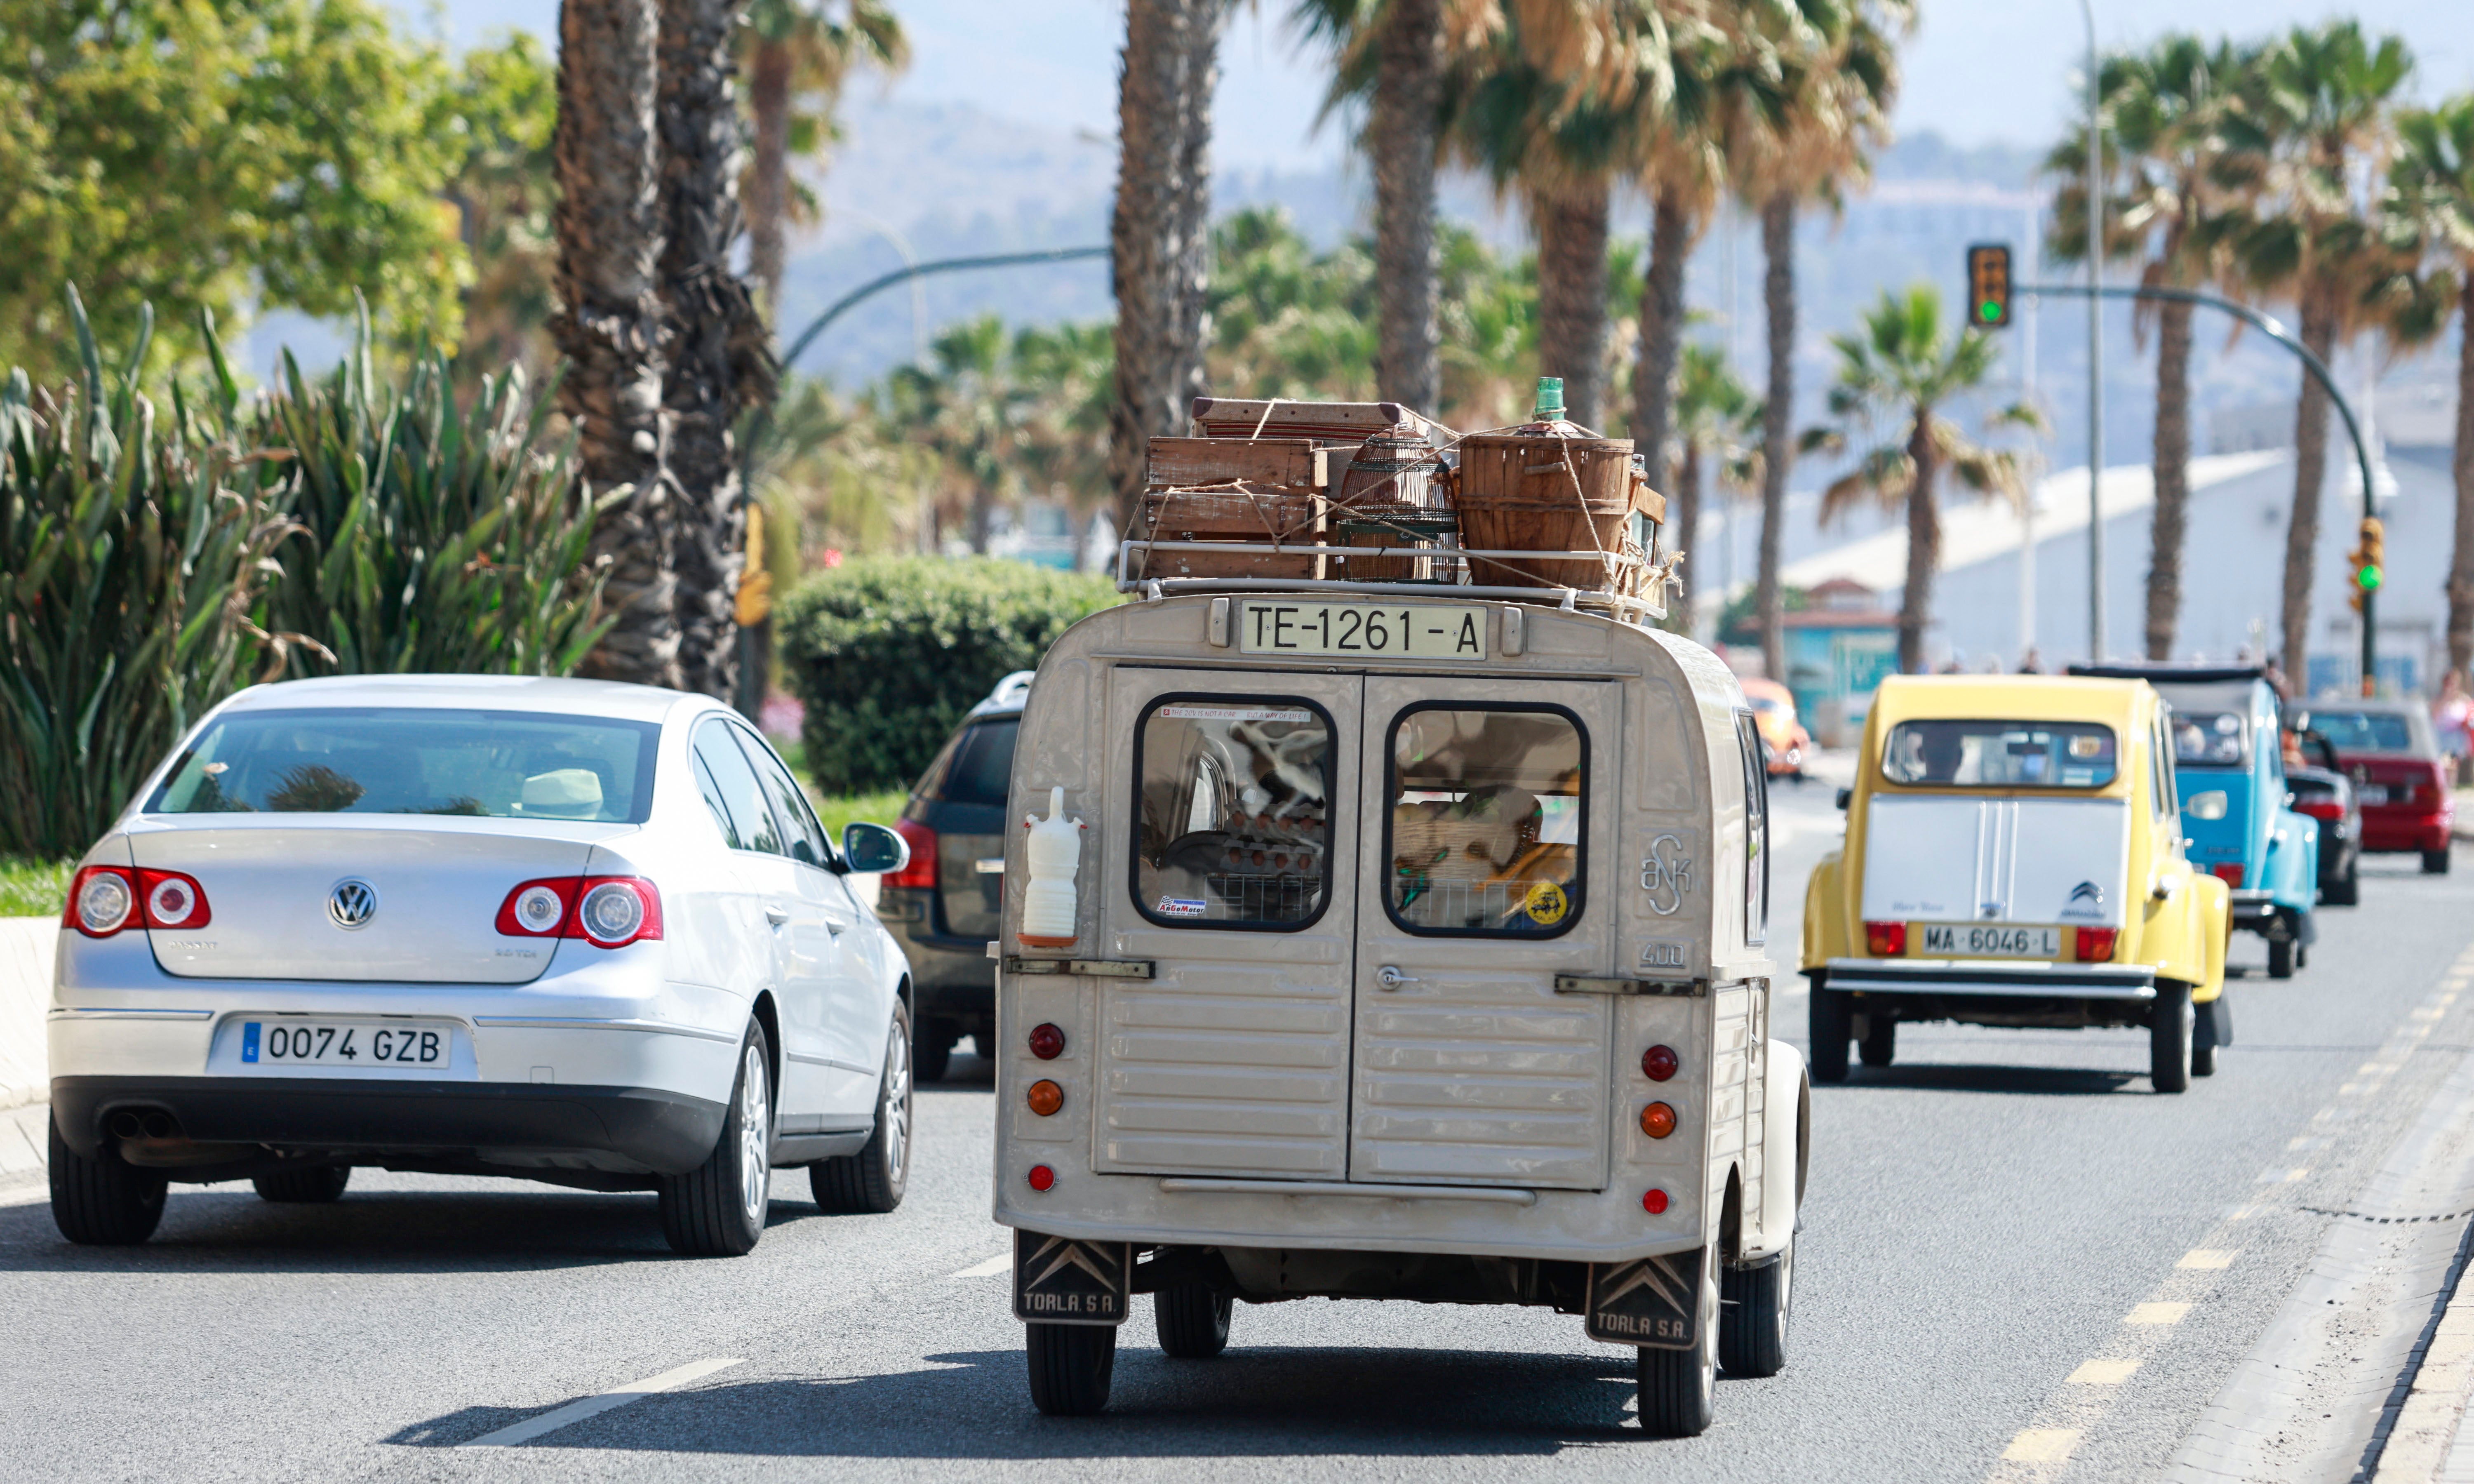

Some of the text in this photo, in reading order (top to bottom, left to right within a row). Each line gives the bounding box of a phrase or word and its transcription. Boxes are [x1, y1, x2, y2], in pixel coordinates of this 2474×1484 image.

[1159, 904, 1204, 913] AnGoMotor
[1642, 944, 1685, 965] 400
[269, 1027, 440, 1062] 0074 GZB
